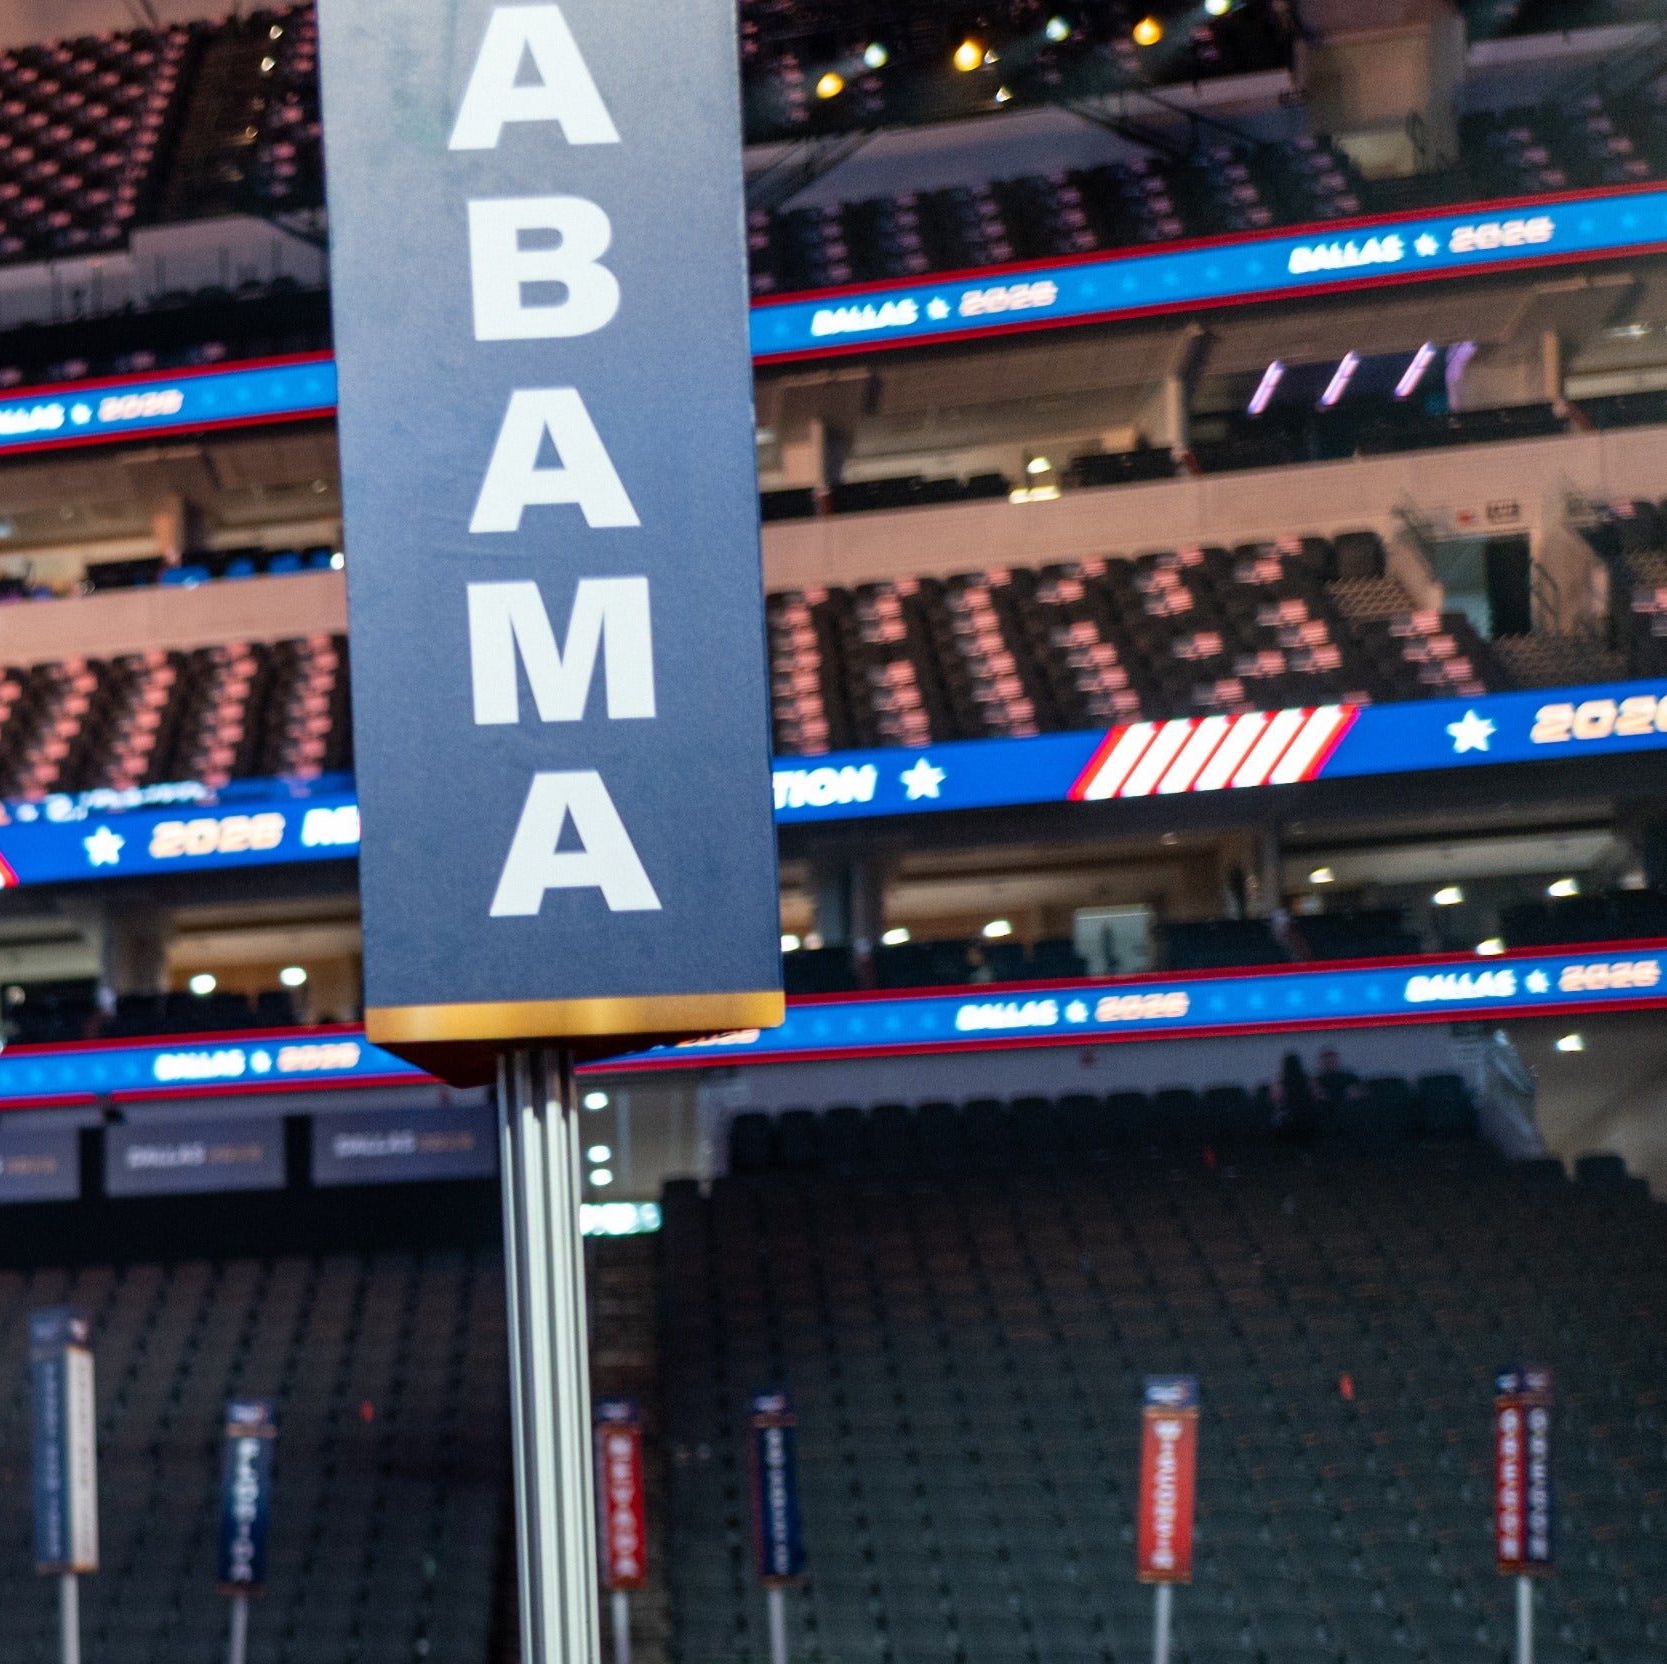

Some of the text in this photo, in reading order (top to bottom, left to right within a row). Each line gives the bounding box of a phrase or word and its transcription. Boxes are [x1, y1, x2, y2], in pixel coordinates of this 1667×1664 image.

[1289, 236, 1404, 273] DALLAS
[812, 300, 917, 335] DALLAS
[449, 4, 662, 917] ABAMA
[150, 814, 285, 857] 2026
[1405, 971, 1515, 1002] DALLAS
[956, 1000, 1058, 1030] DALLAS
